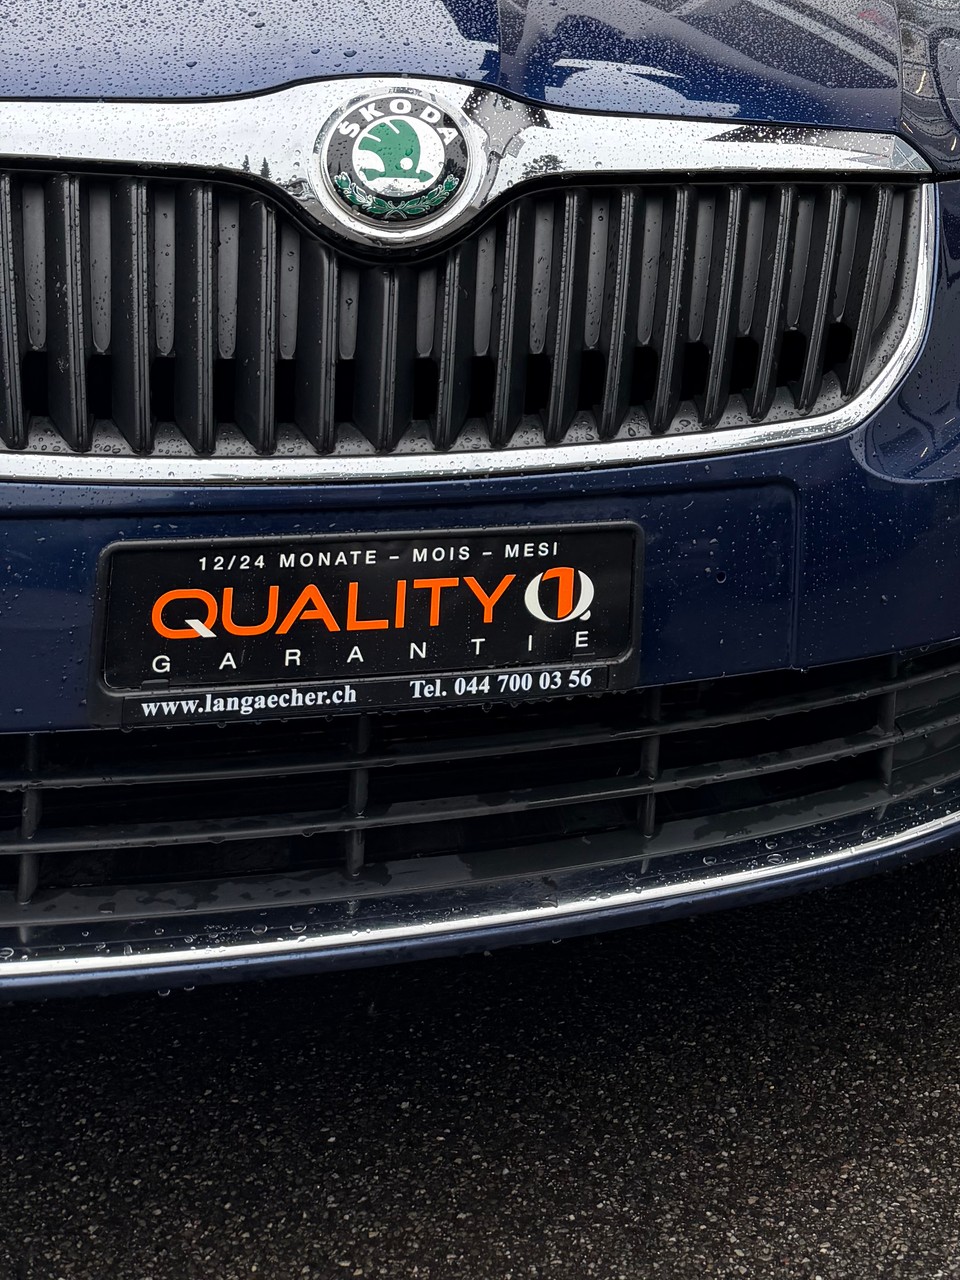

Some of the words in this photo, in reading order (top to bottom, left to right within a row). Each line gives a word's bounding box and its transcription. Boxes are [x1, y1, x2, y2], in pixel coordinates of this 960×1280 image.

[198, 554, 265, 571] 12/24
[279, 549, 377, 568] MONATE
[412, 546, 471, 563] MOIS
[504, 541, 558, 559] MESI
[151, 574, 517, 640] QUALITY
[152, 630, 589, 673] GARANTIE
[141, 684, 357, 717] www.langaecher.ch
[410, 679, 447, 699] Tel.
[454, 675, 490, 695] 044
[497, 672, 533, 693] 700
[539, 670, 562, 690] 03
[568, 668, 592, 687] 56
